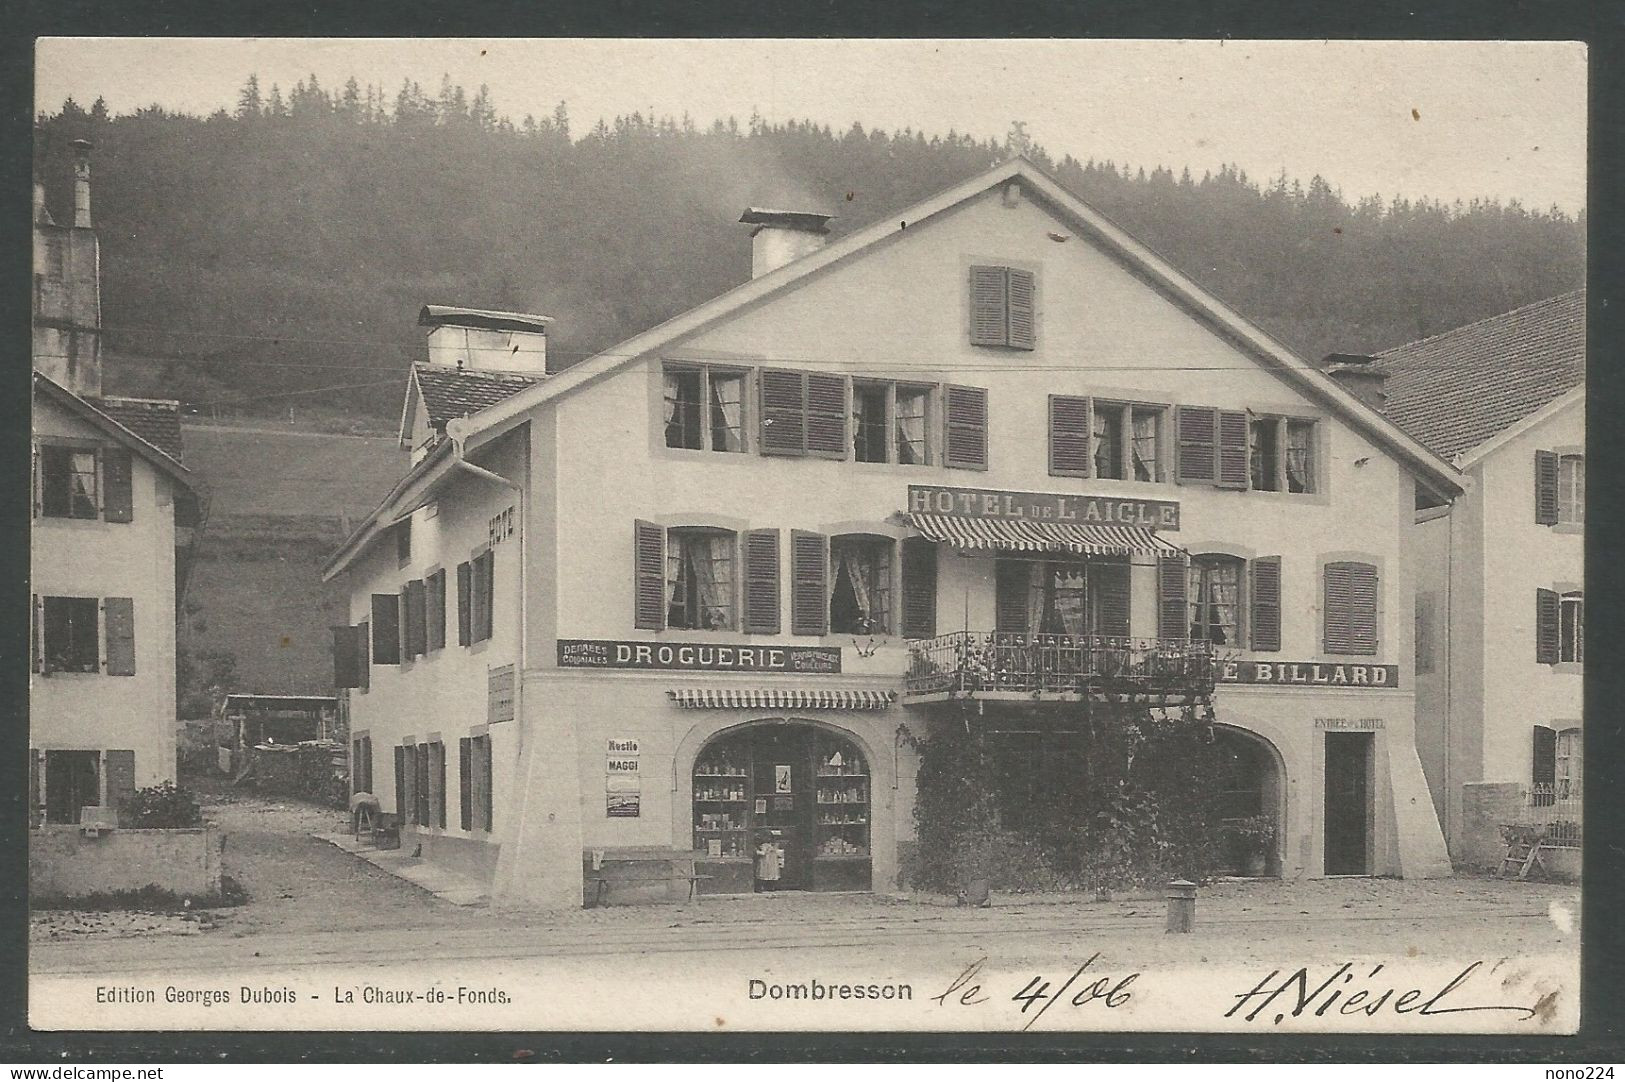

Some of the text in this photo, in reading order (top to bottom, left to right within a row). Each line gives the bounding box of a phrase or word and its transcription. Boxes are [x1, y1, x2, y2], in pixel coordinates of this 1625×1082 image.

[615, 644, 786, 668] DROGUERIE
[1255, 664, 1387, 684] BILLARD
[608, 760, 638, 771] MAGGI
[748, 979, 913, 1000] Dombresson
[930, 956, 990, 1006] le
[96, 987, 155, 1004] Edition
[165, 987, 231, 1007] Georges
[240, 987, 296, 1004] Dubois
[335, 987, 354, 1004] La
[363, 987, 512, 1005] Chaux-de-Fonds.
